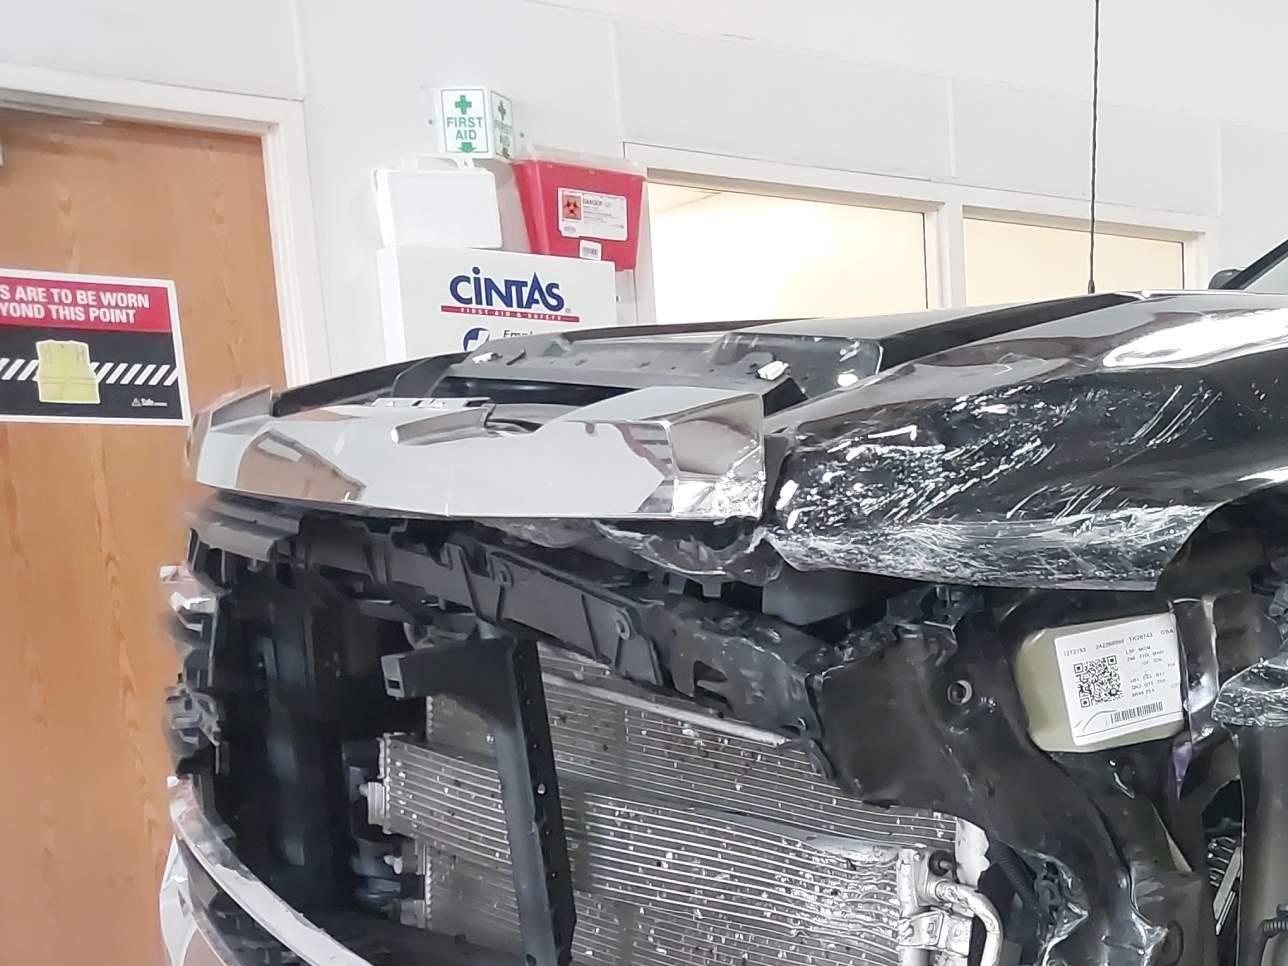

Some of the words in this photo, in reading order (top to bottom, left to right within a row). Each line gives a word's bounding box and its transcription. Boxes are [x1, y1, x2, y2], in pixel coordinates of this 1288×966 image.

[446, 116, 483, 128] FIRST
[455, 129, 477, 140] AID
[15, 286, 48, 302] ARE
[50, 288, 73, 304] TO
[76, 290, 97, 306] BE
[100, 292, 150, 309] WORN
[48, 304, 86, 322] THIS
[89, 308, 136, 324] POINT
